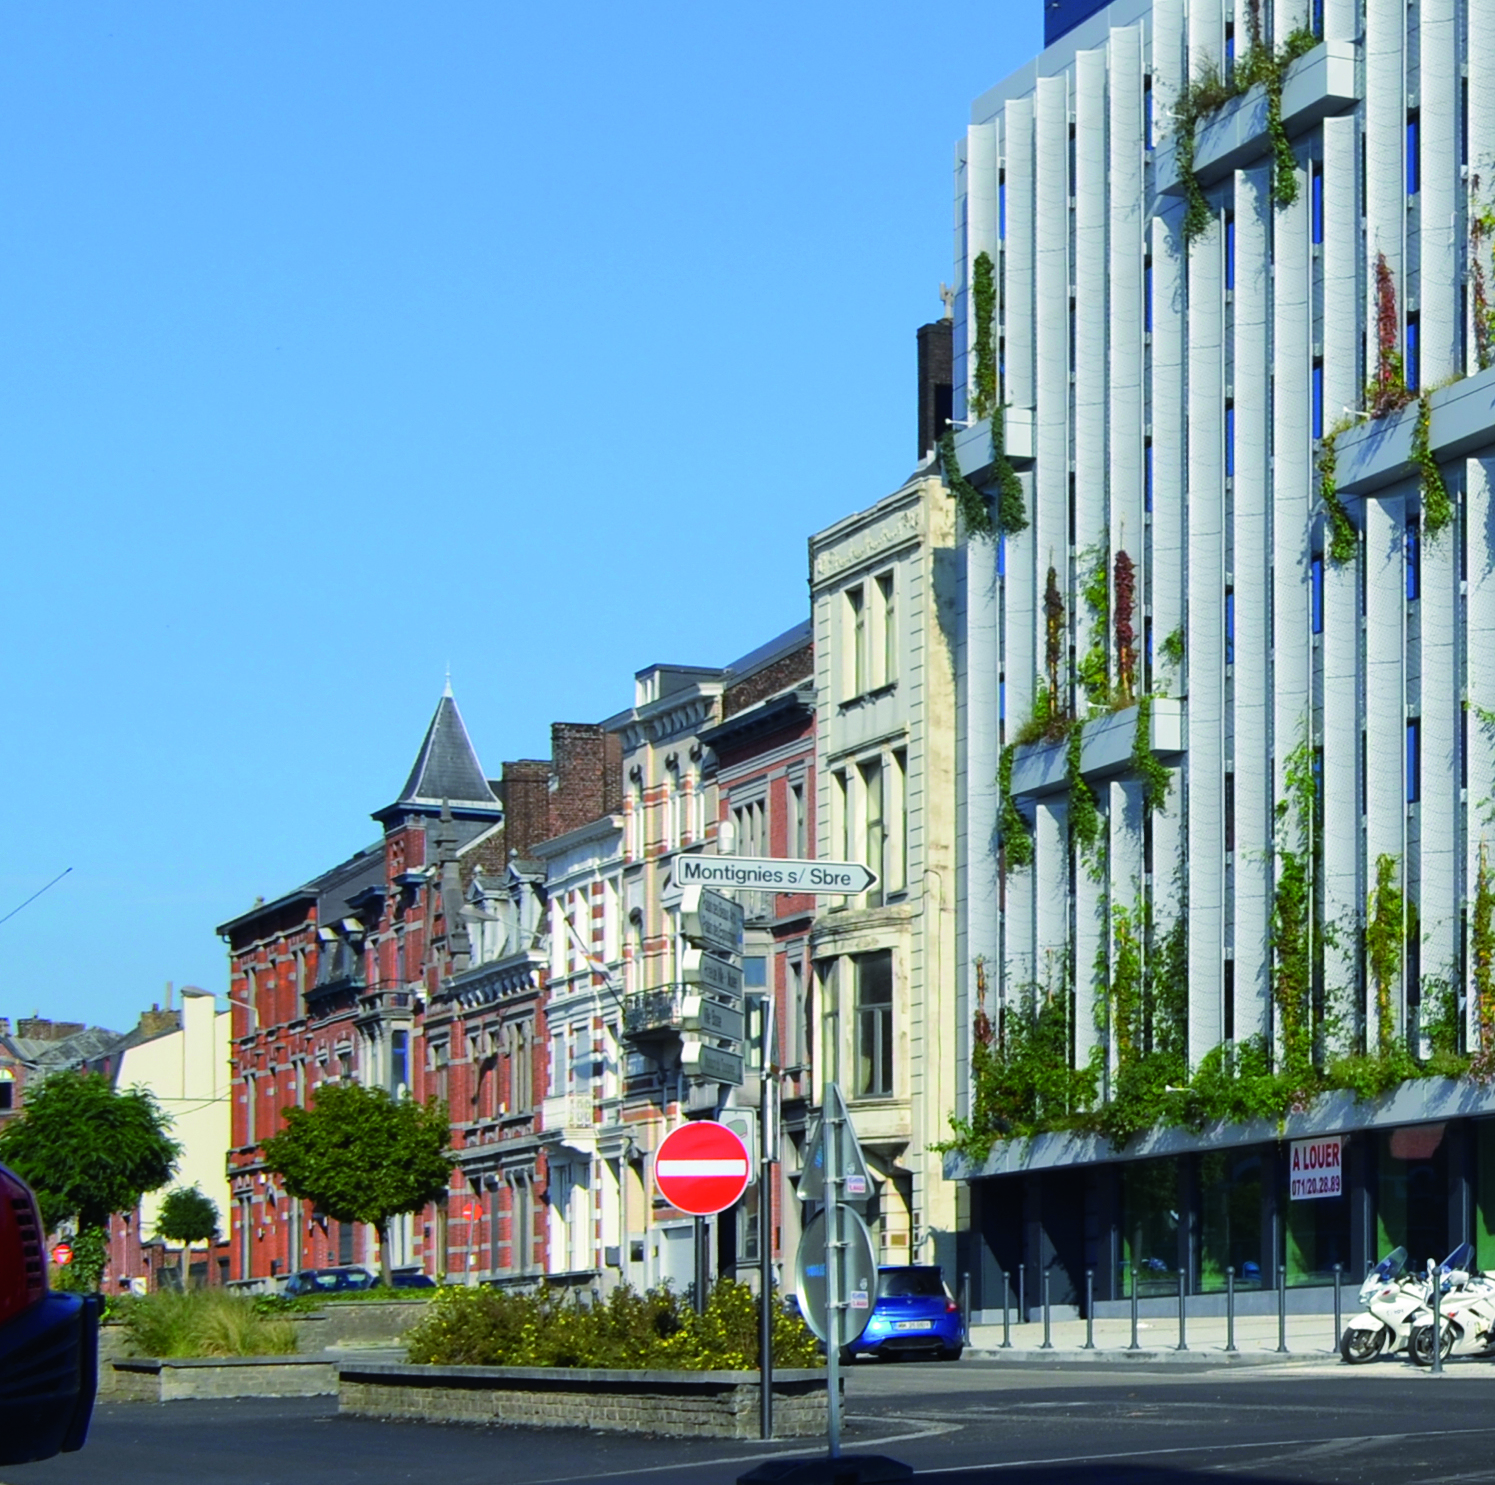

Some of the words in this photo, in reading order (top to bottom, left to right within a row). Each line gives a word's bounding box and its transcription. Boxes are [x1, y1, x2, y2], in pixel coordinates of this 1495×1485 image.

[684, 862, 783, 884] Montignies
[810, 868, 851, 885] Sbre
[1292, 1147, 1300, 1171] A
[1303, 1143, 1340, 1170] LOUER
